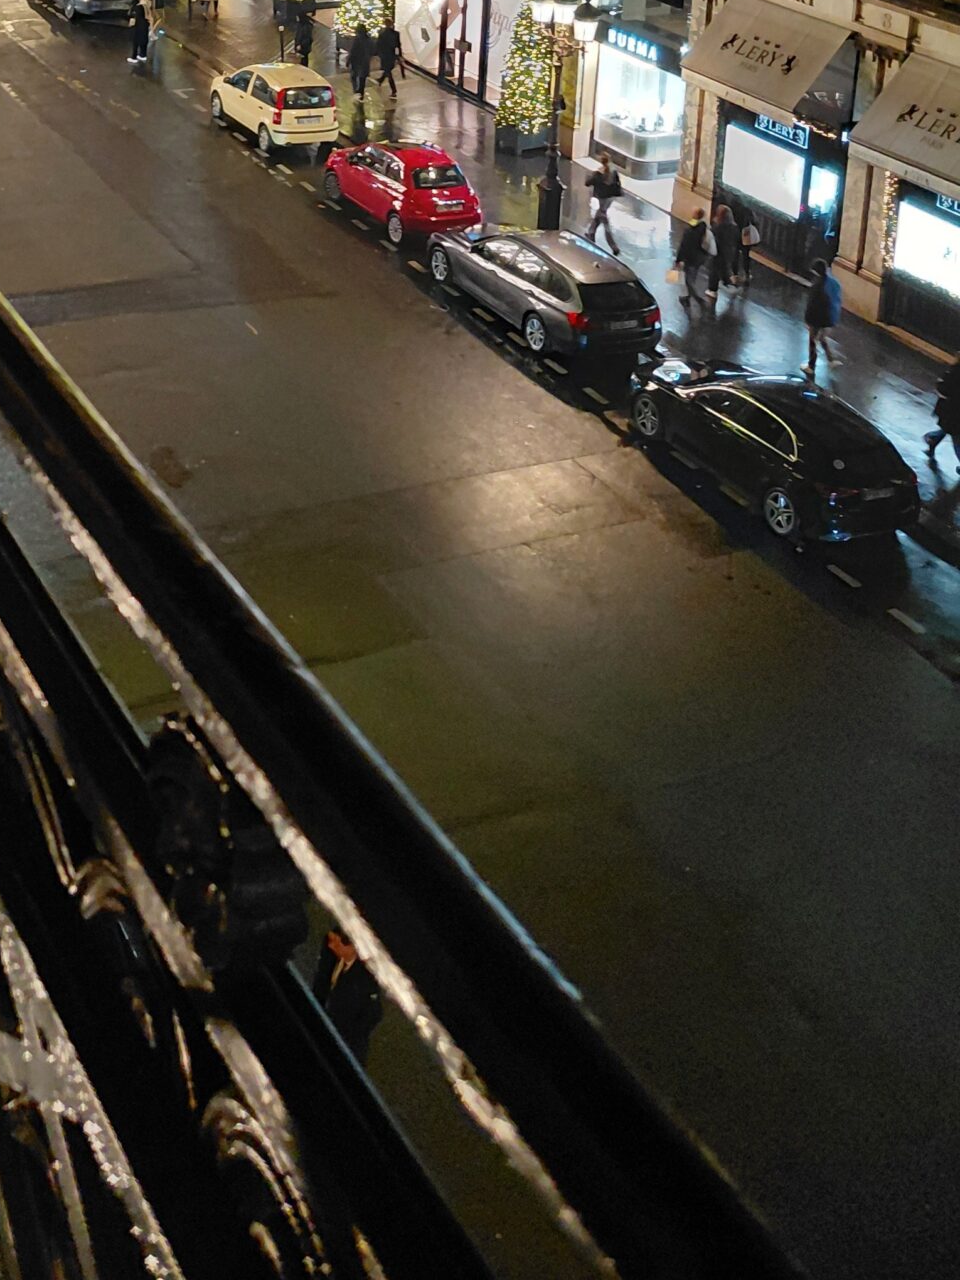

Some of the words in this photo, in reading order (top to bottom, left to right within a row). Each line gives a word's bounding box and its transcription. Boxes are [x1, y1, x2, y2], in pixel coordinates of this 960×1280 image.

[607, 27, 658, 61] BURMA
[735, 39, 784, 68] LERY
[768, 117, 798, 141] LERY
[913, 111, 960, 144] LER
